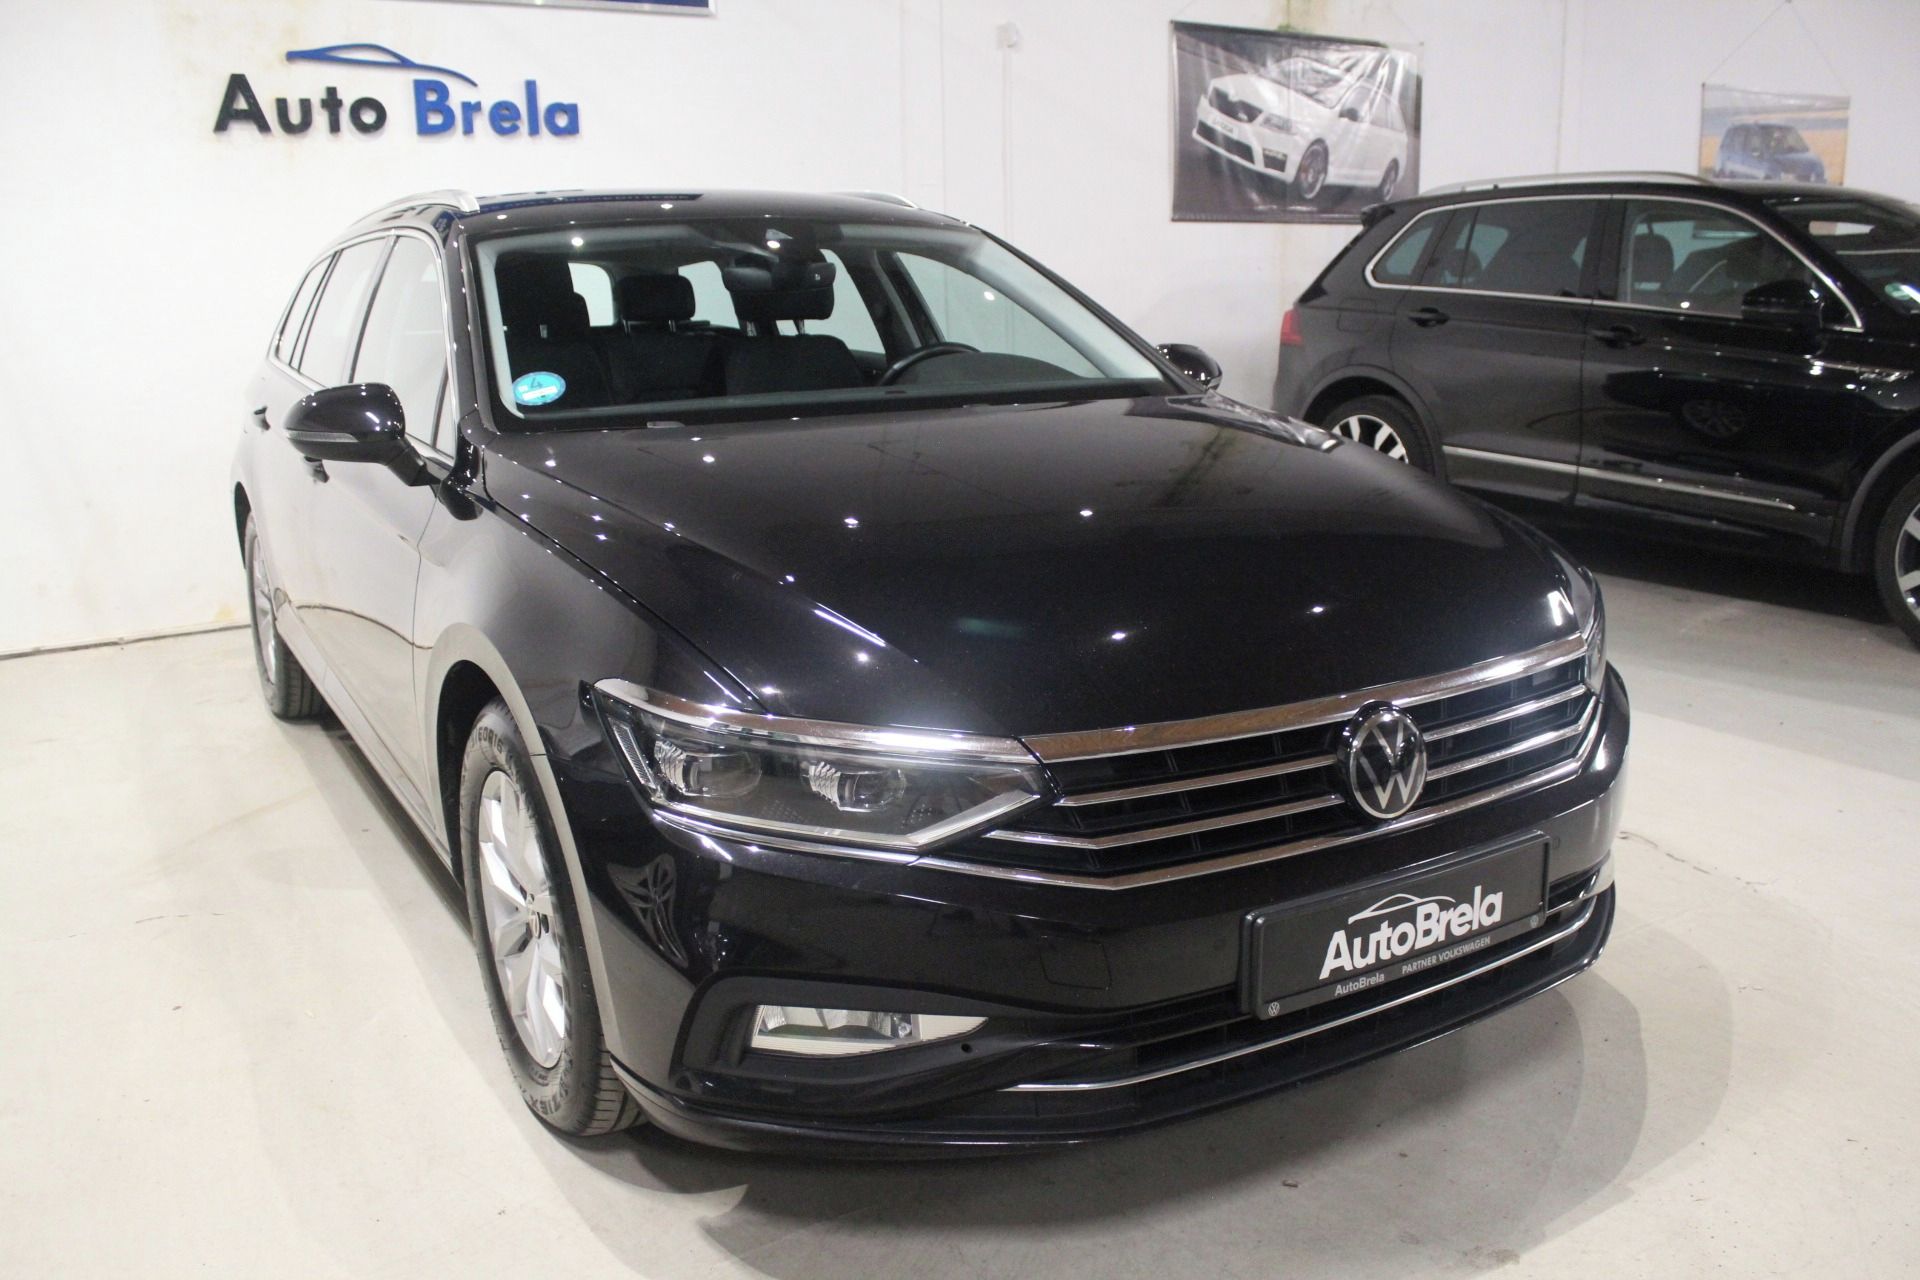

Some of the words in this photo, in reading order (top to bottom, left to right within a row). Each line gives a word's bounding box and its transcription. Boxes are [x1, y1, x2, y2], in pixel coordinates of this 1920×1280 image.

[213, 72, 388, 136] Auto
[412, 78, 580, 137] Brela
[1318, 884, 1504, 981] AutoBrela
[1334, 971, 1385, 998] AutoBrela
[1401, 955, 1438, 975] PARTNER
[1438, 935, 1491, 964] VOLKSWAGEN
